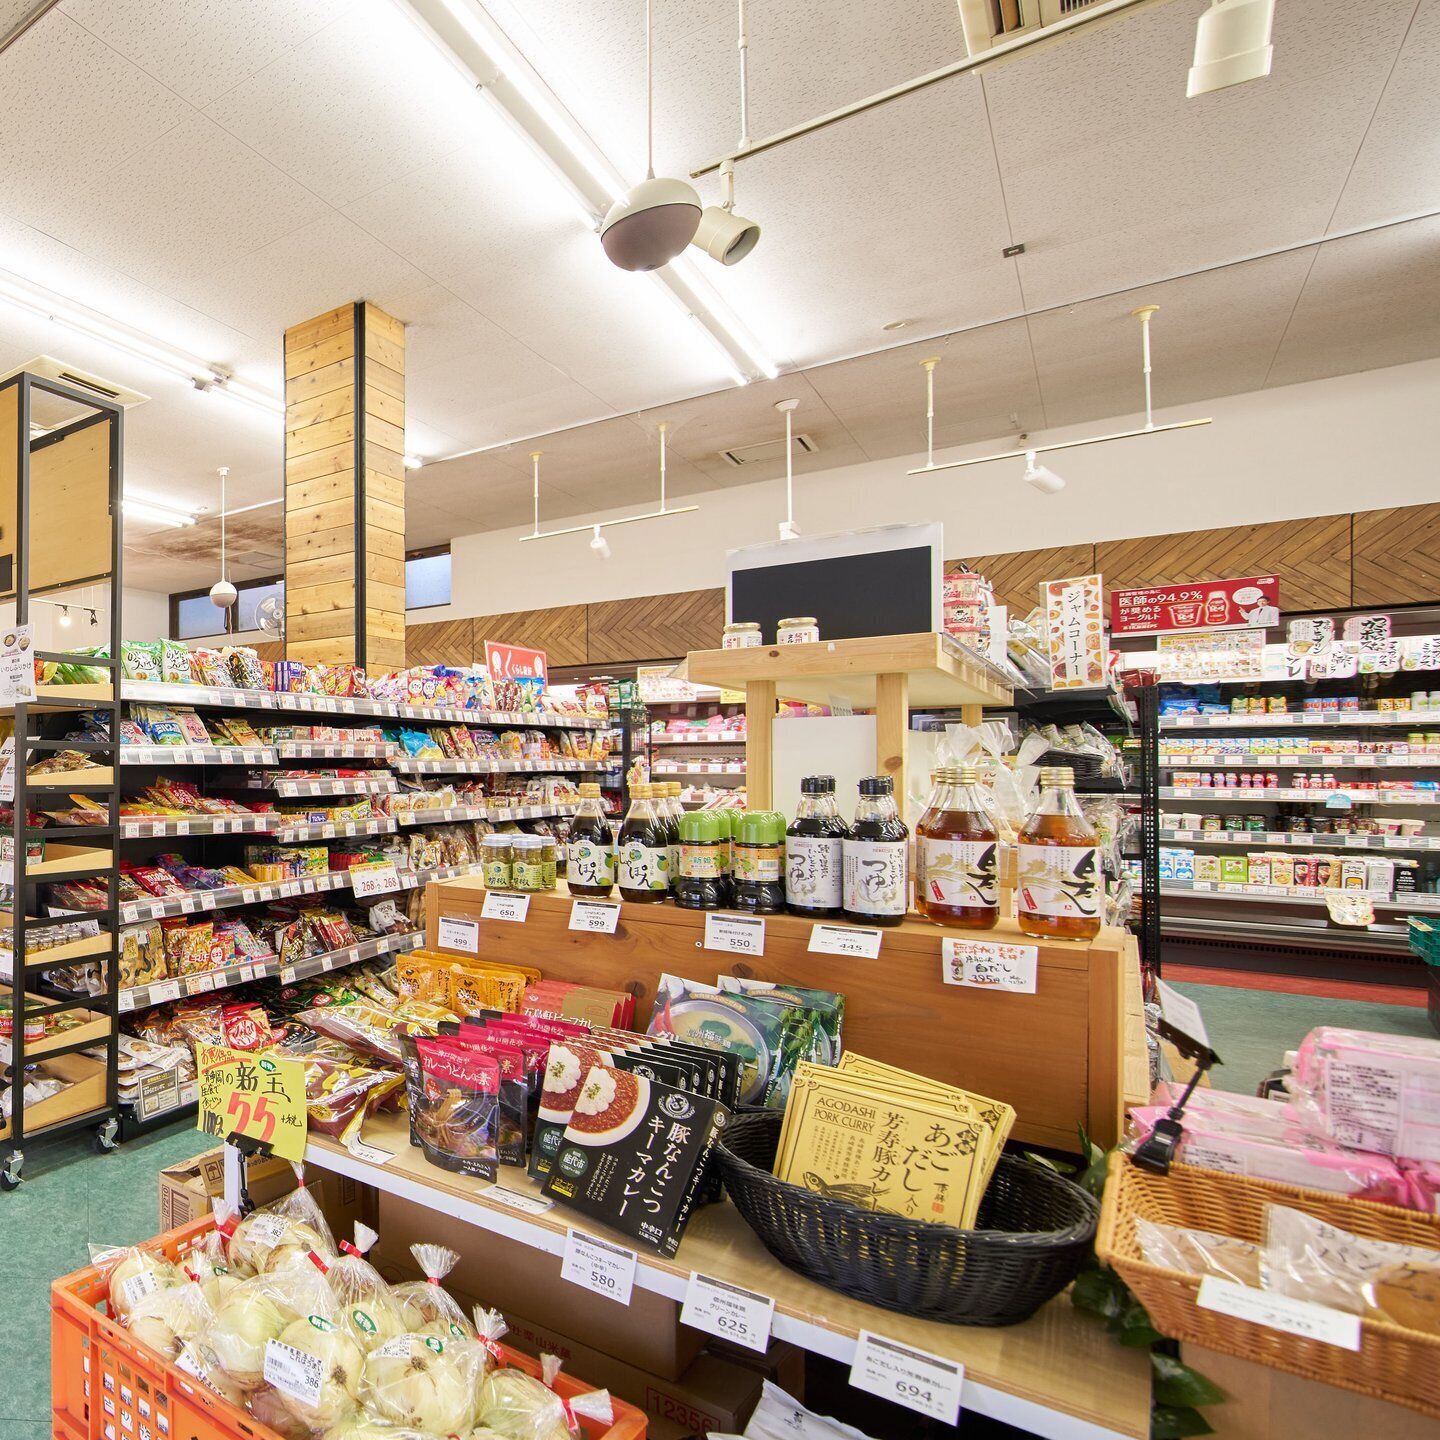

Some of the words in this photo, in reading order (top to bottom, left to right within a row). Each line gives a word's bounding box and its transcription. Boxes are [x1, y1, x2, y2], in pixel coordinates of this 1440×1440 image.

[1120, 614, 1160, 622] ヨーグルト
[1066, 592, 1086, 676] ジャムコーナー
[588, 919, 605, 927] 599
[453, 937, 469, 946] 499
[729, 938, 751, 948] 550
[816, 1096, 876, 1119] AGODASHI
[227, 1091, 279, 1144] 55
[814, 1109, 840, 1124] PORK
[841, 1116, 875, 1133] CURRY
[619, 1115, 666, 1217] キーマカレー
[643, 1121, 693, 1214] 豚なんこつ
[640, 1221, 664, 1237] 中辛口
[590, 1270, 616, 1289] 580
[709, 1303, 747, 1320] グリーンカレー
[717, 1316, 749, 1335] 625
[304, 1375, 320, 1389] 386
[895, 1380, 934, 1402] 694
